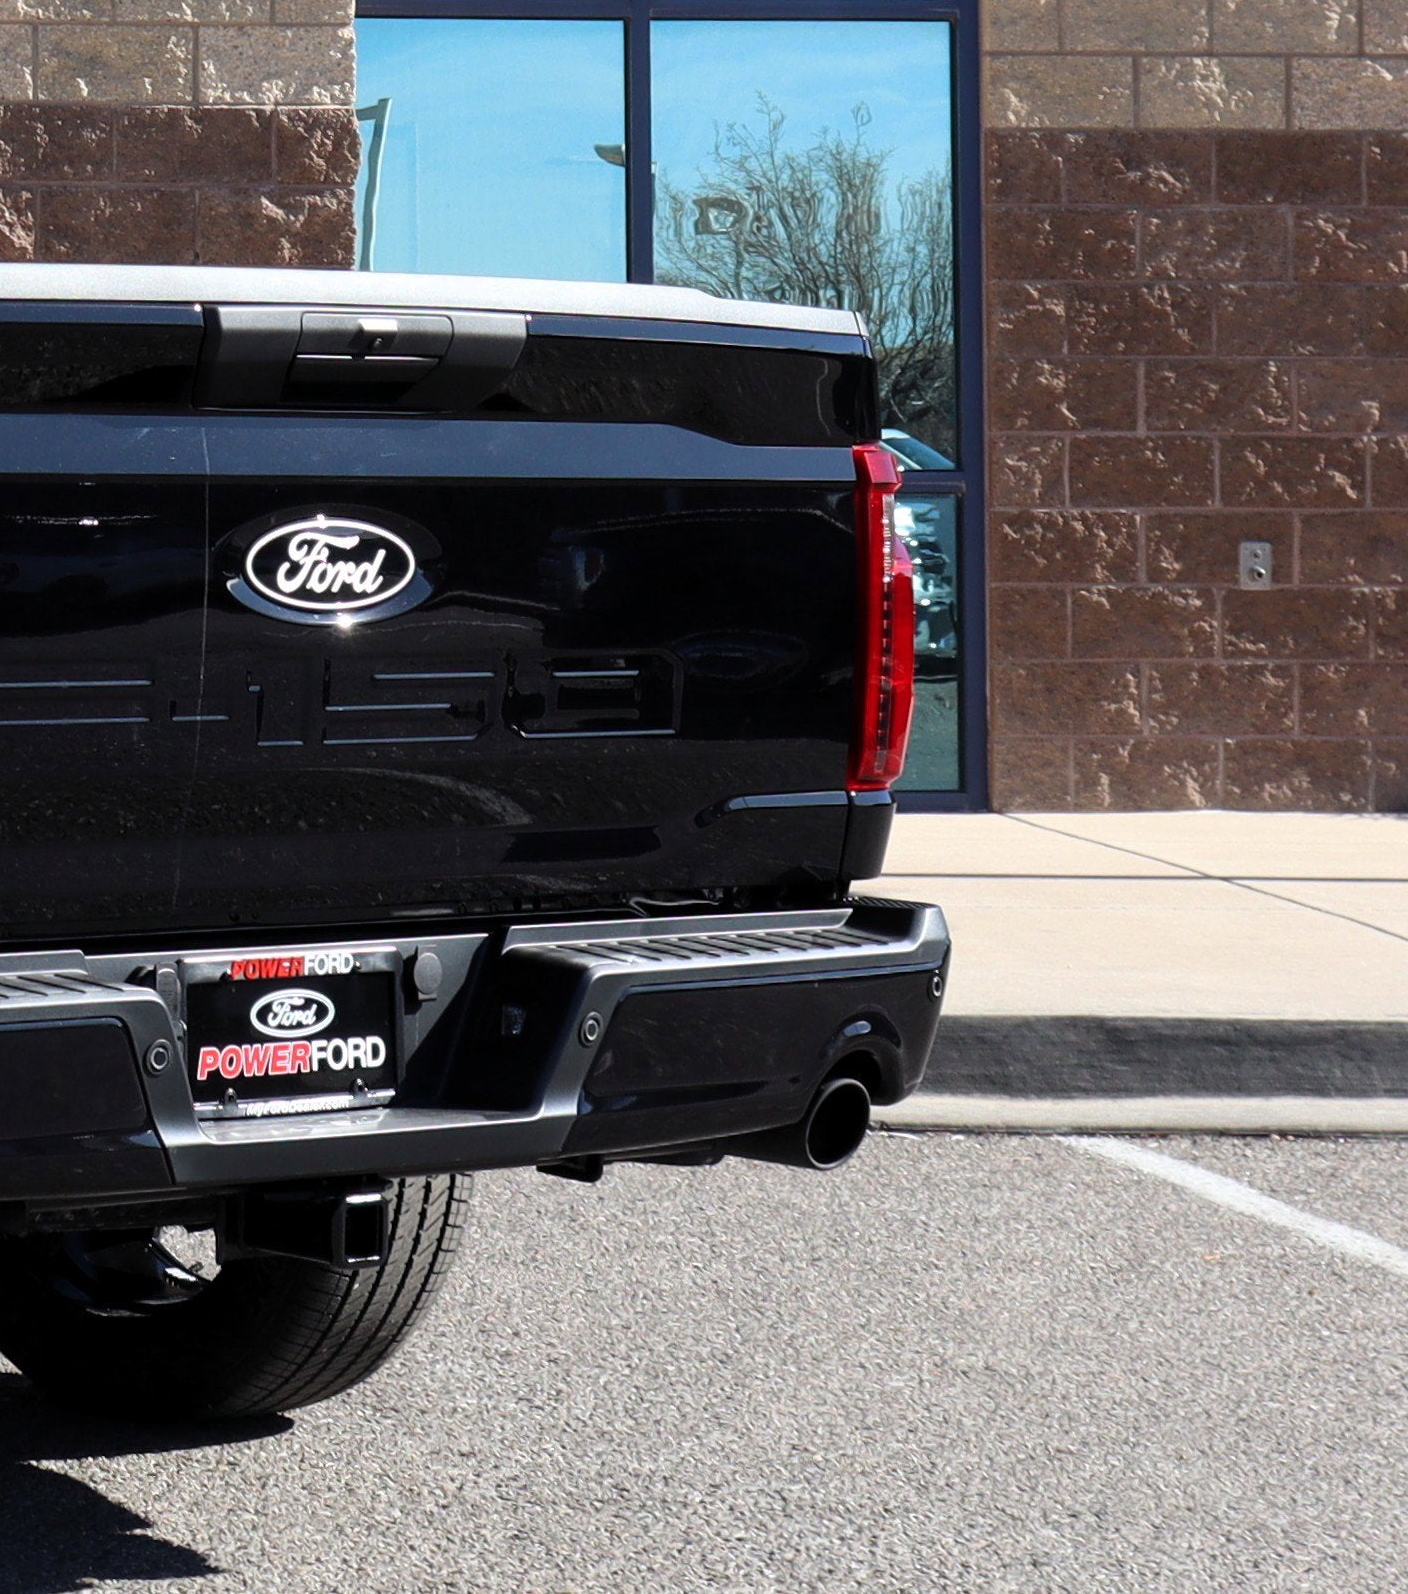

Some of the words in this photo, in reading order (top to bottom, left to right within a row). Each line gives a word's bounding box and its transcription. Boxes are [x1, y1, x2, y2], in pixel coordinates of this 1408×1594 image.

[277, 531, 387, 594] Ford
[267, 997, 316, 1027] Ford
[197, 1036, 385, 1081] POWERFORD
